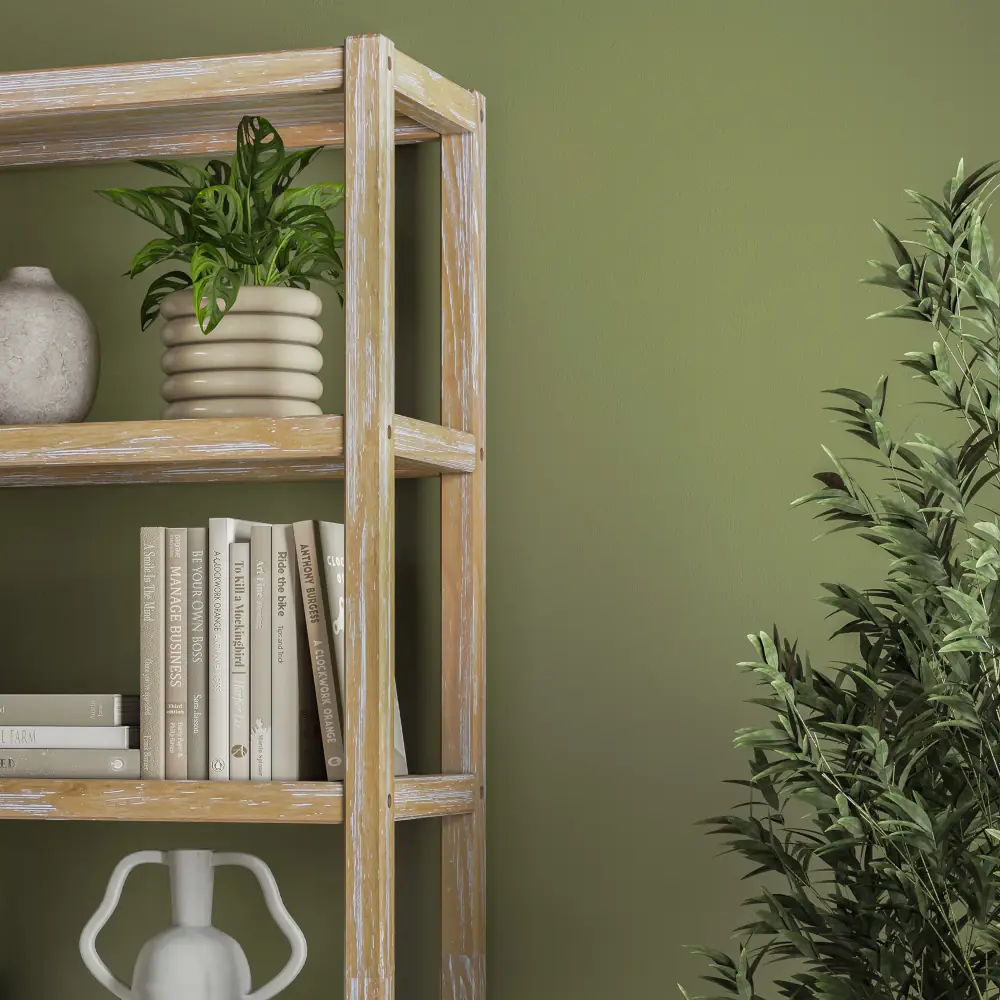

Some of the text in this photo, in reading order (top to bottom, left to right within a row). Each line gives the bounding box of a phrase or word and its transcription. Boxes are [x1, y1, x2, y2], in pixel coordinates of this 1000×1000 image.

[143, 543, 155, 551] A
[143, 551, 155, 574] Smile
[234, 561, 245, 574] To
[256, 560, 266, 575] Art
[143, 585, 155, 599] The
[169, 566, 182, 622] MANAGE
[234, 575, 245, 594] Kill
[277, 551, 288, 617] Ride the bike
[300, 544, 320, 624] ANTHONY BURGESS
[143, 601, 155, 621] Mind
[191, 550, 204, 663] BE YOUR OWN BOSS
[213, 602, 222, 632] ORANGE
[232, 603, 245, 667] Mockingbird
[169, 625, 182, 688] BUSINESS
[315, 649, 332, 705] CLOCKWORK
[10, 729, 36, 744] FARM
[323, 708, 337, 744] ORANGE
